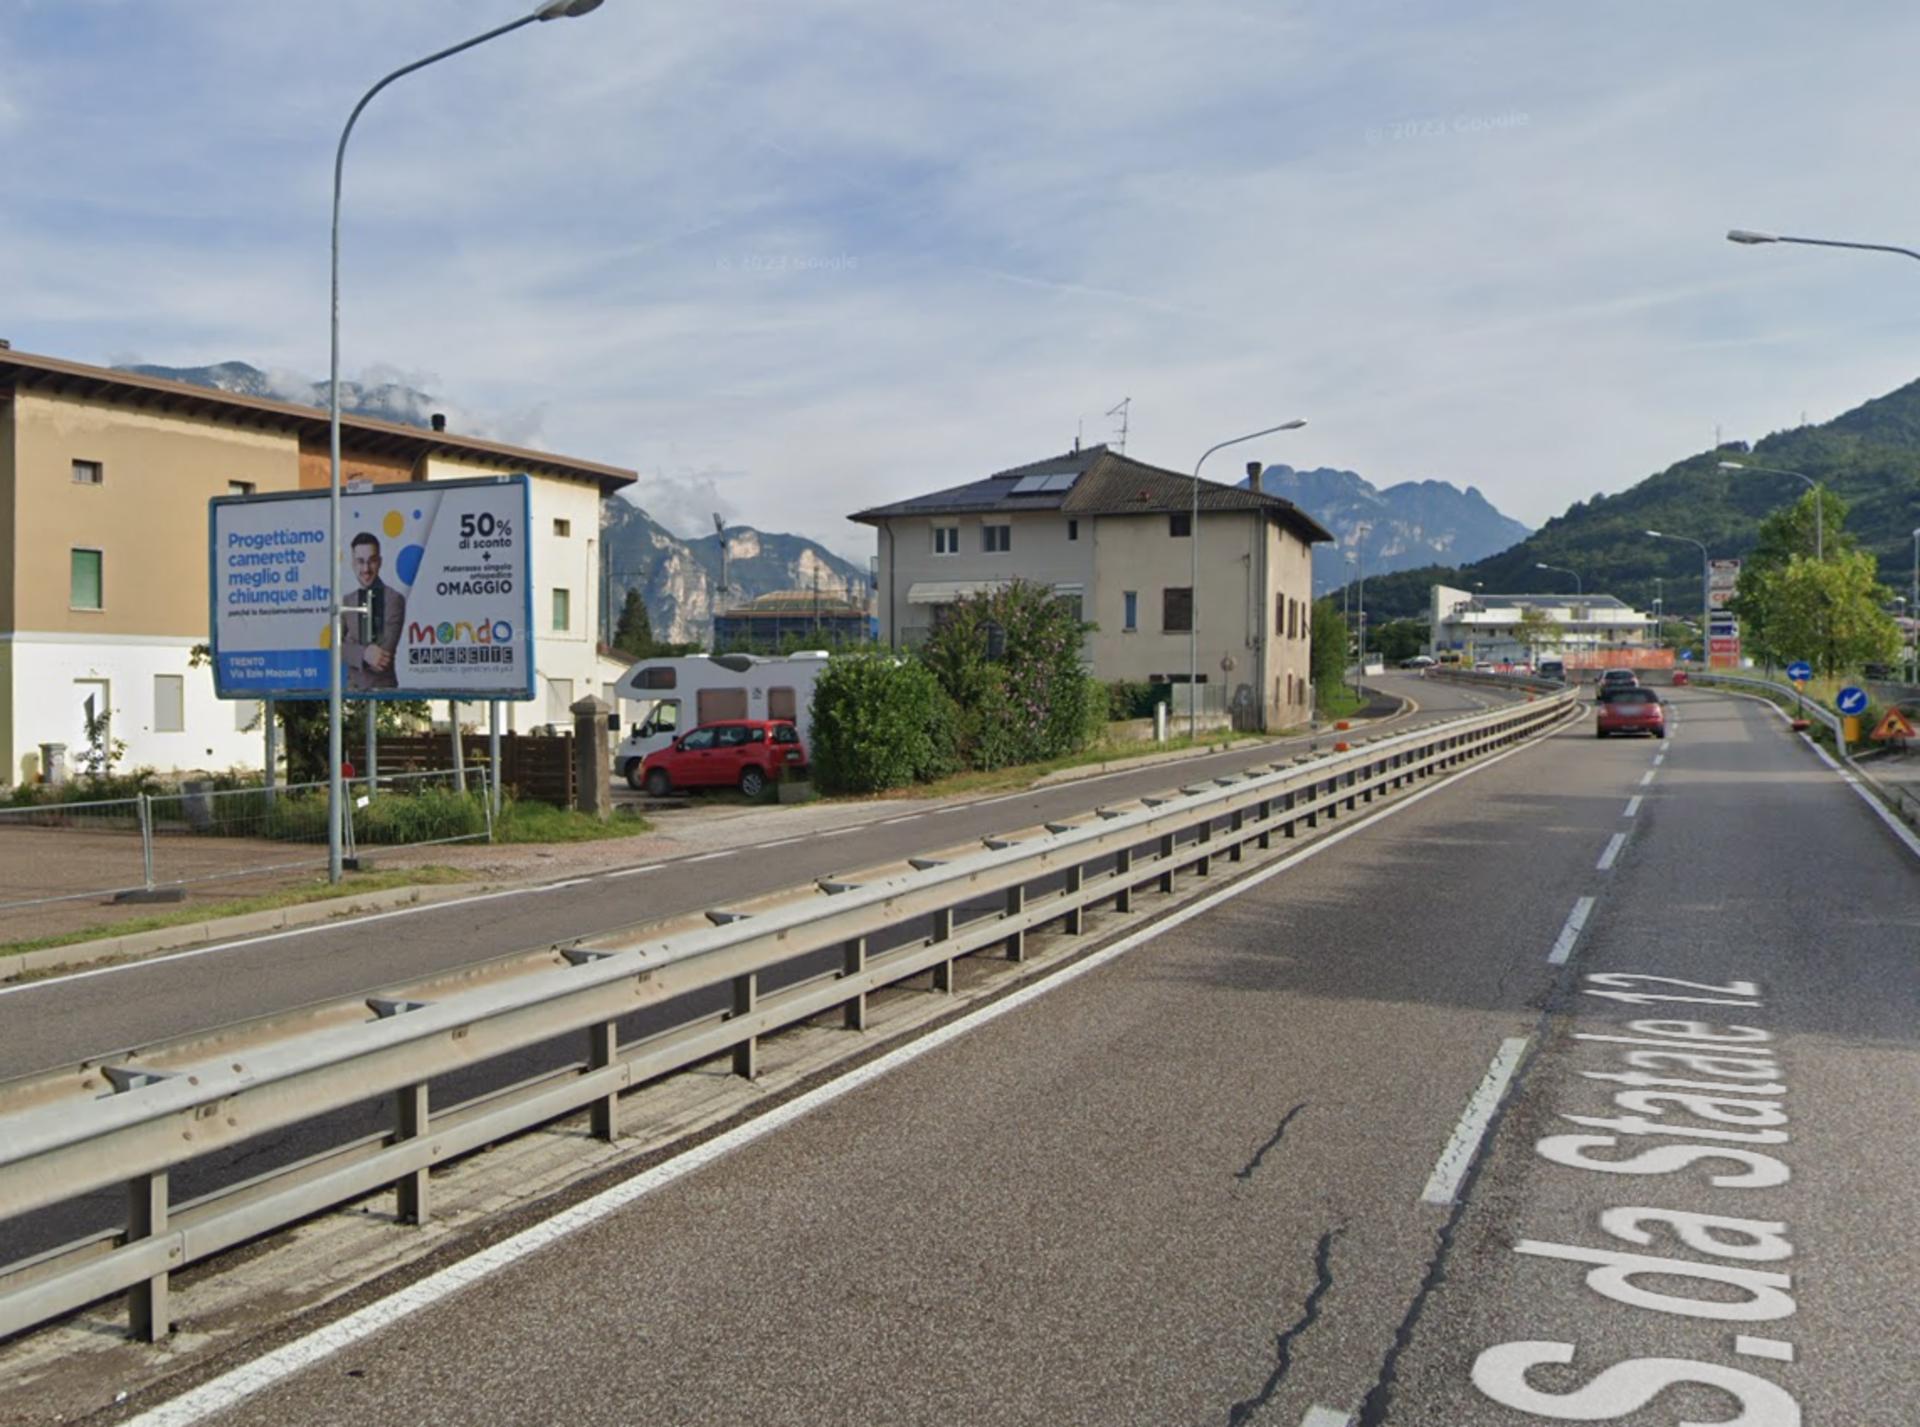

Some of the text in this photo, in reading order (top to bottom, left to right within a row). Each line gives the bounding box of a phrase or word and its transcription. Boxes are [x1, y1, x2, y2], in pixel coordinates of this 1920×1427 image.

[460, 511, 513, 538] 50%
[229, 530, 325, 550] Progettiamo
[458, 537, 513, 550] di sconto
[228, 549, 306, 567] camerette
[229, 565, 300, 588] meglio di
[228, 584, 330, 606] chiunque altr
[436, 580, 513, 596] OMAGGIO
[408, 617, 514, 645] mondo
[230, 656, 265, 667] TRENTO
[408, 646, 514, 665] CAMERETTE
